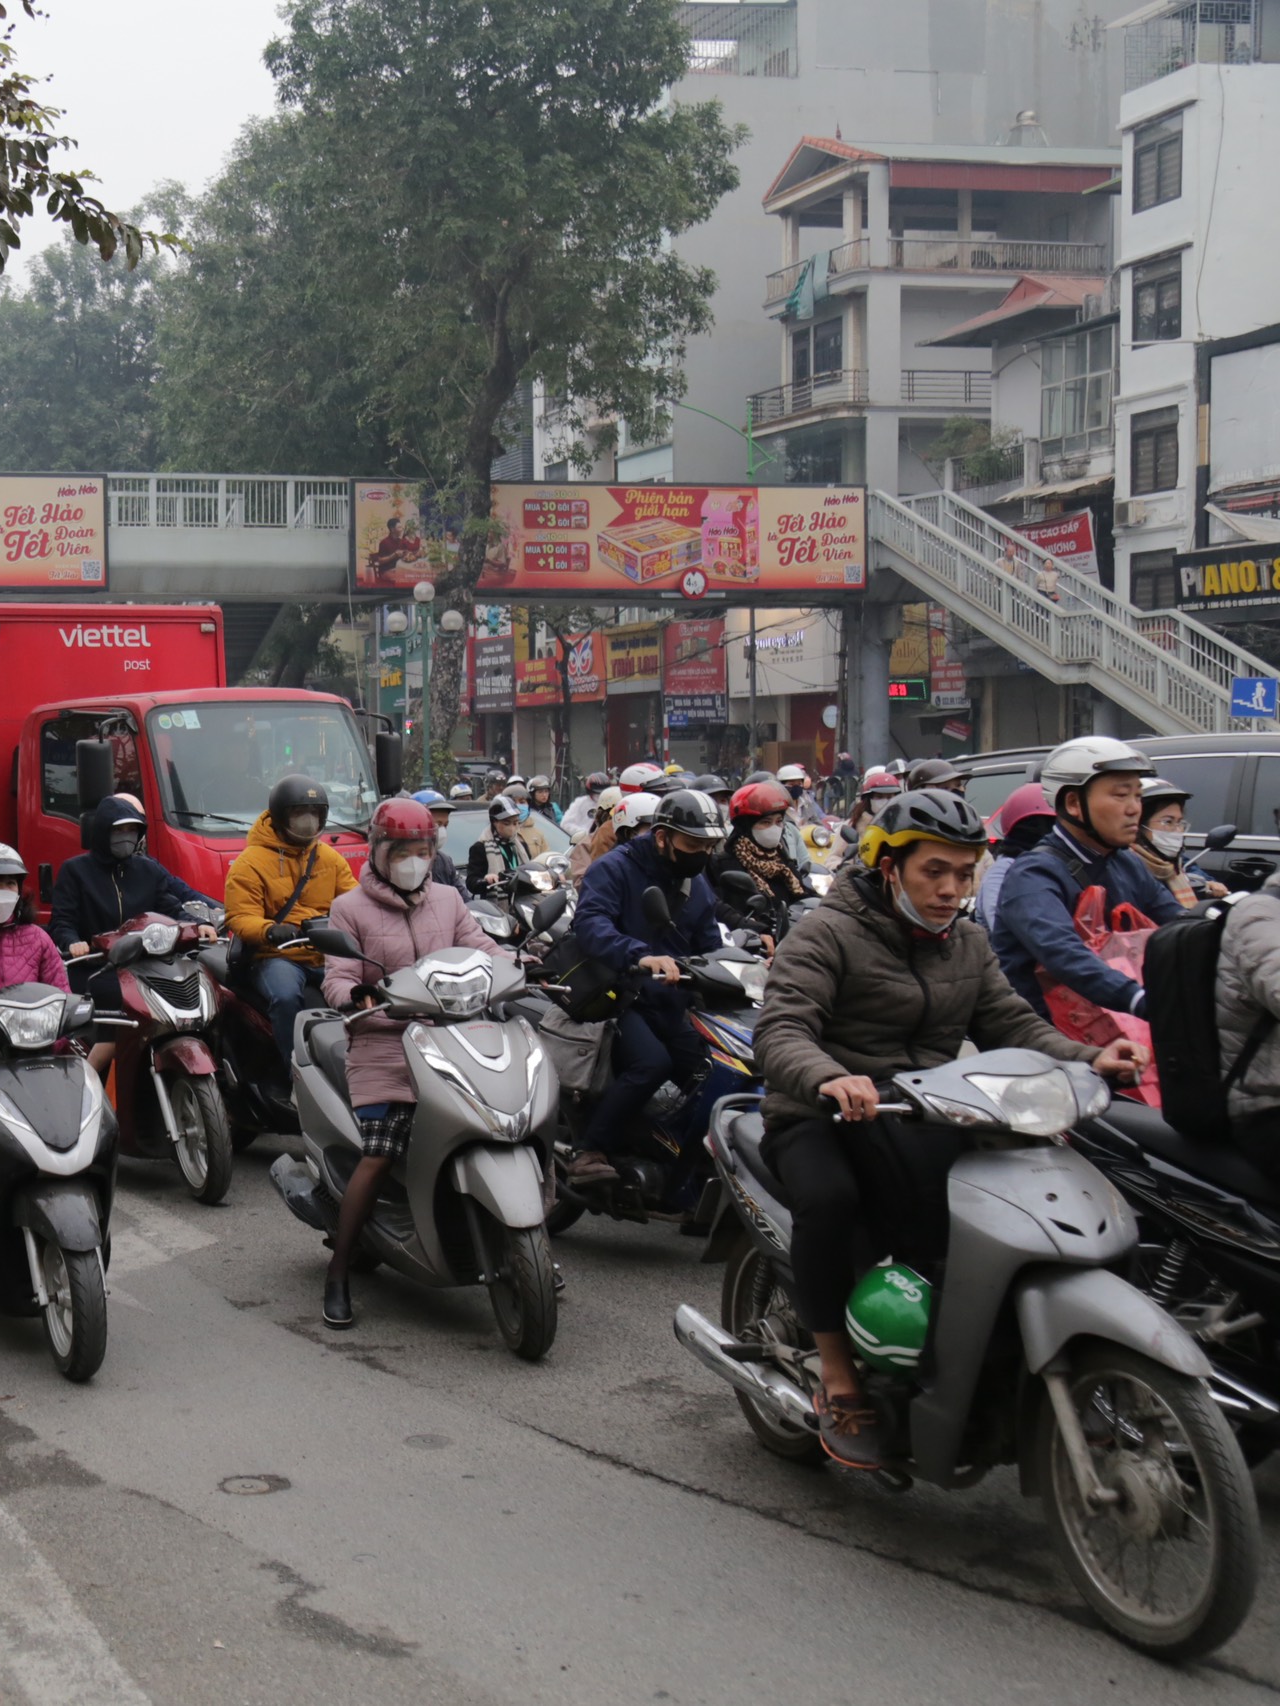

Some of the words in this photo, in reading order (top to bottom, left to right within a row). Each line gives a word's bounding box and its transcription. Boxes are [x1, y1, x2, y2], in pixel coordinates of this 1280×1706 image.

[57, 484, 77, 497] Hảo
[78, 482, 98, 495] Hảo
[625, 489, 665, 504] Phiên
[667, 490, 694, 504] bản
[524, 503, 540, 511] MUA
[542, 501, 556, 511] 30
[824, 494, 841, 506] Hảo
[842, 492, 859, 504] Hảo
[3, 504, 37, 528] Tết
[40, 502, 84, 525] Hảo
[635, 504, 660, 520] giới
[662, 504, 689, 520] hạn
[777, 513, 806, 535] Tết
[808, 511, 847, 531] Hảo
[1040, 527, 1059, 539] CAO
[3, 528, 53, 562] Tết
[54, 525, 95, 541] Đoàn
[56, 541, 91, 557] Viên
[525, 545, 541, 554] MUA
[542, 543, 554, 554] 10
[767, 531, 778, 542] là
[777, 535, 819, 567] Tết
[821, 532, 856, 547] Đoàn
[822, 547, 853, 562] Viên
[59, 624, 151, 648] viettel
[124, 658, 151, 672] post
[884, 1270, 923, 1303] Grab
